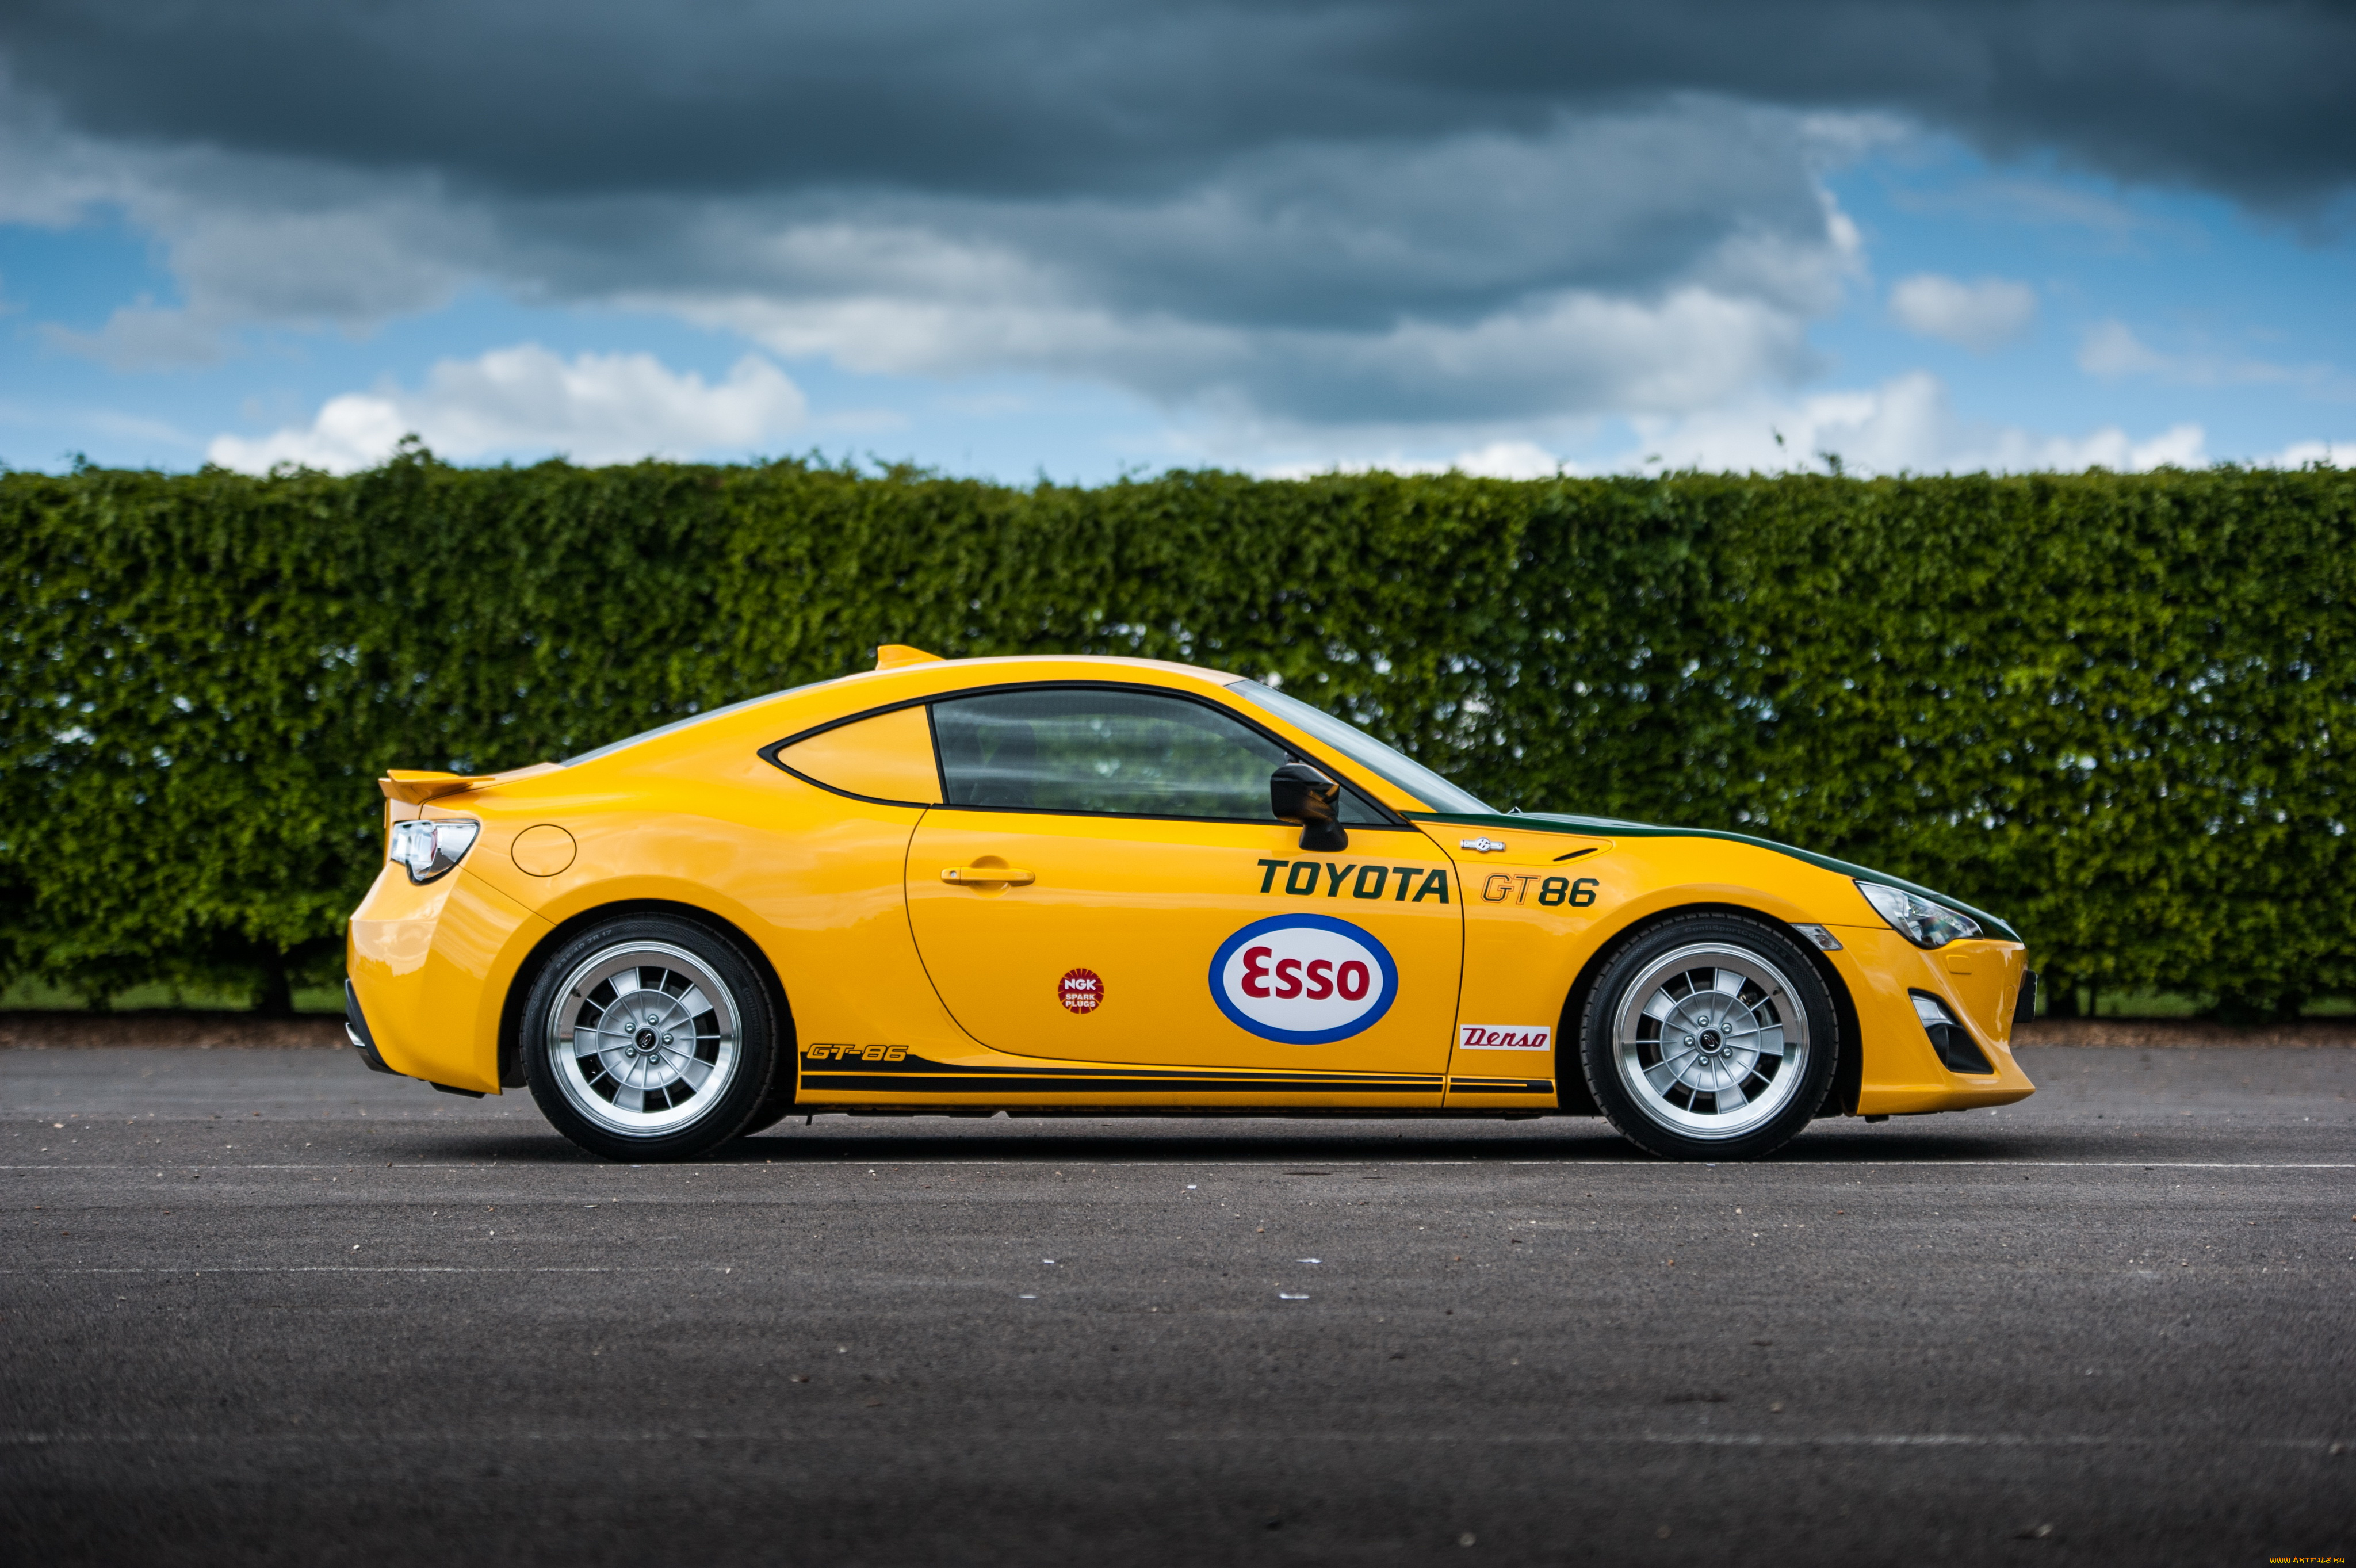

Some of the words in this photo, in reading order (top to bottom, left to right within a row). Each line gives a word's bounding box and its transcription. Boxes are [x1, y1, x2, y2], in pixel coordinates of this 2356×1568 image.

[1257, 859, 1449, 904] TOYOTA
[1481, 873, 1600, 907] GT86
[1064, 978, 1096, 990] NGK
[1462, 1027, 1548, 1047] Denso
[806, 1043, 909, 1061] GT-86
